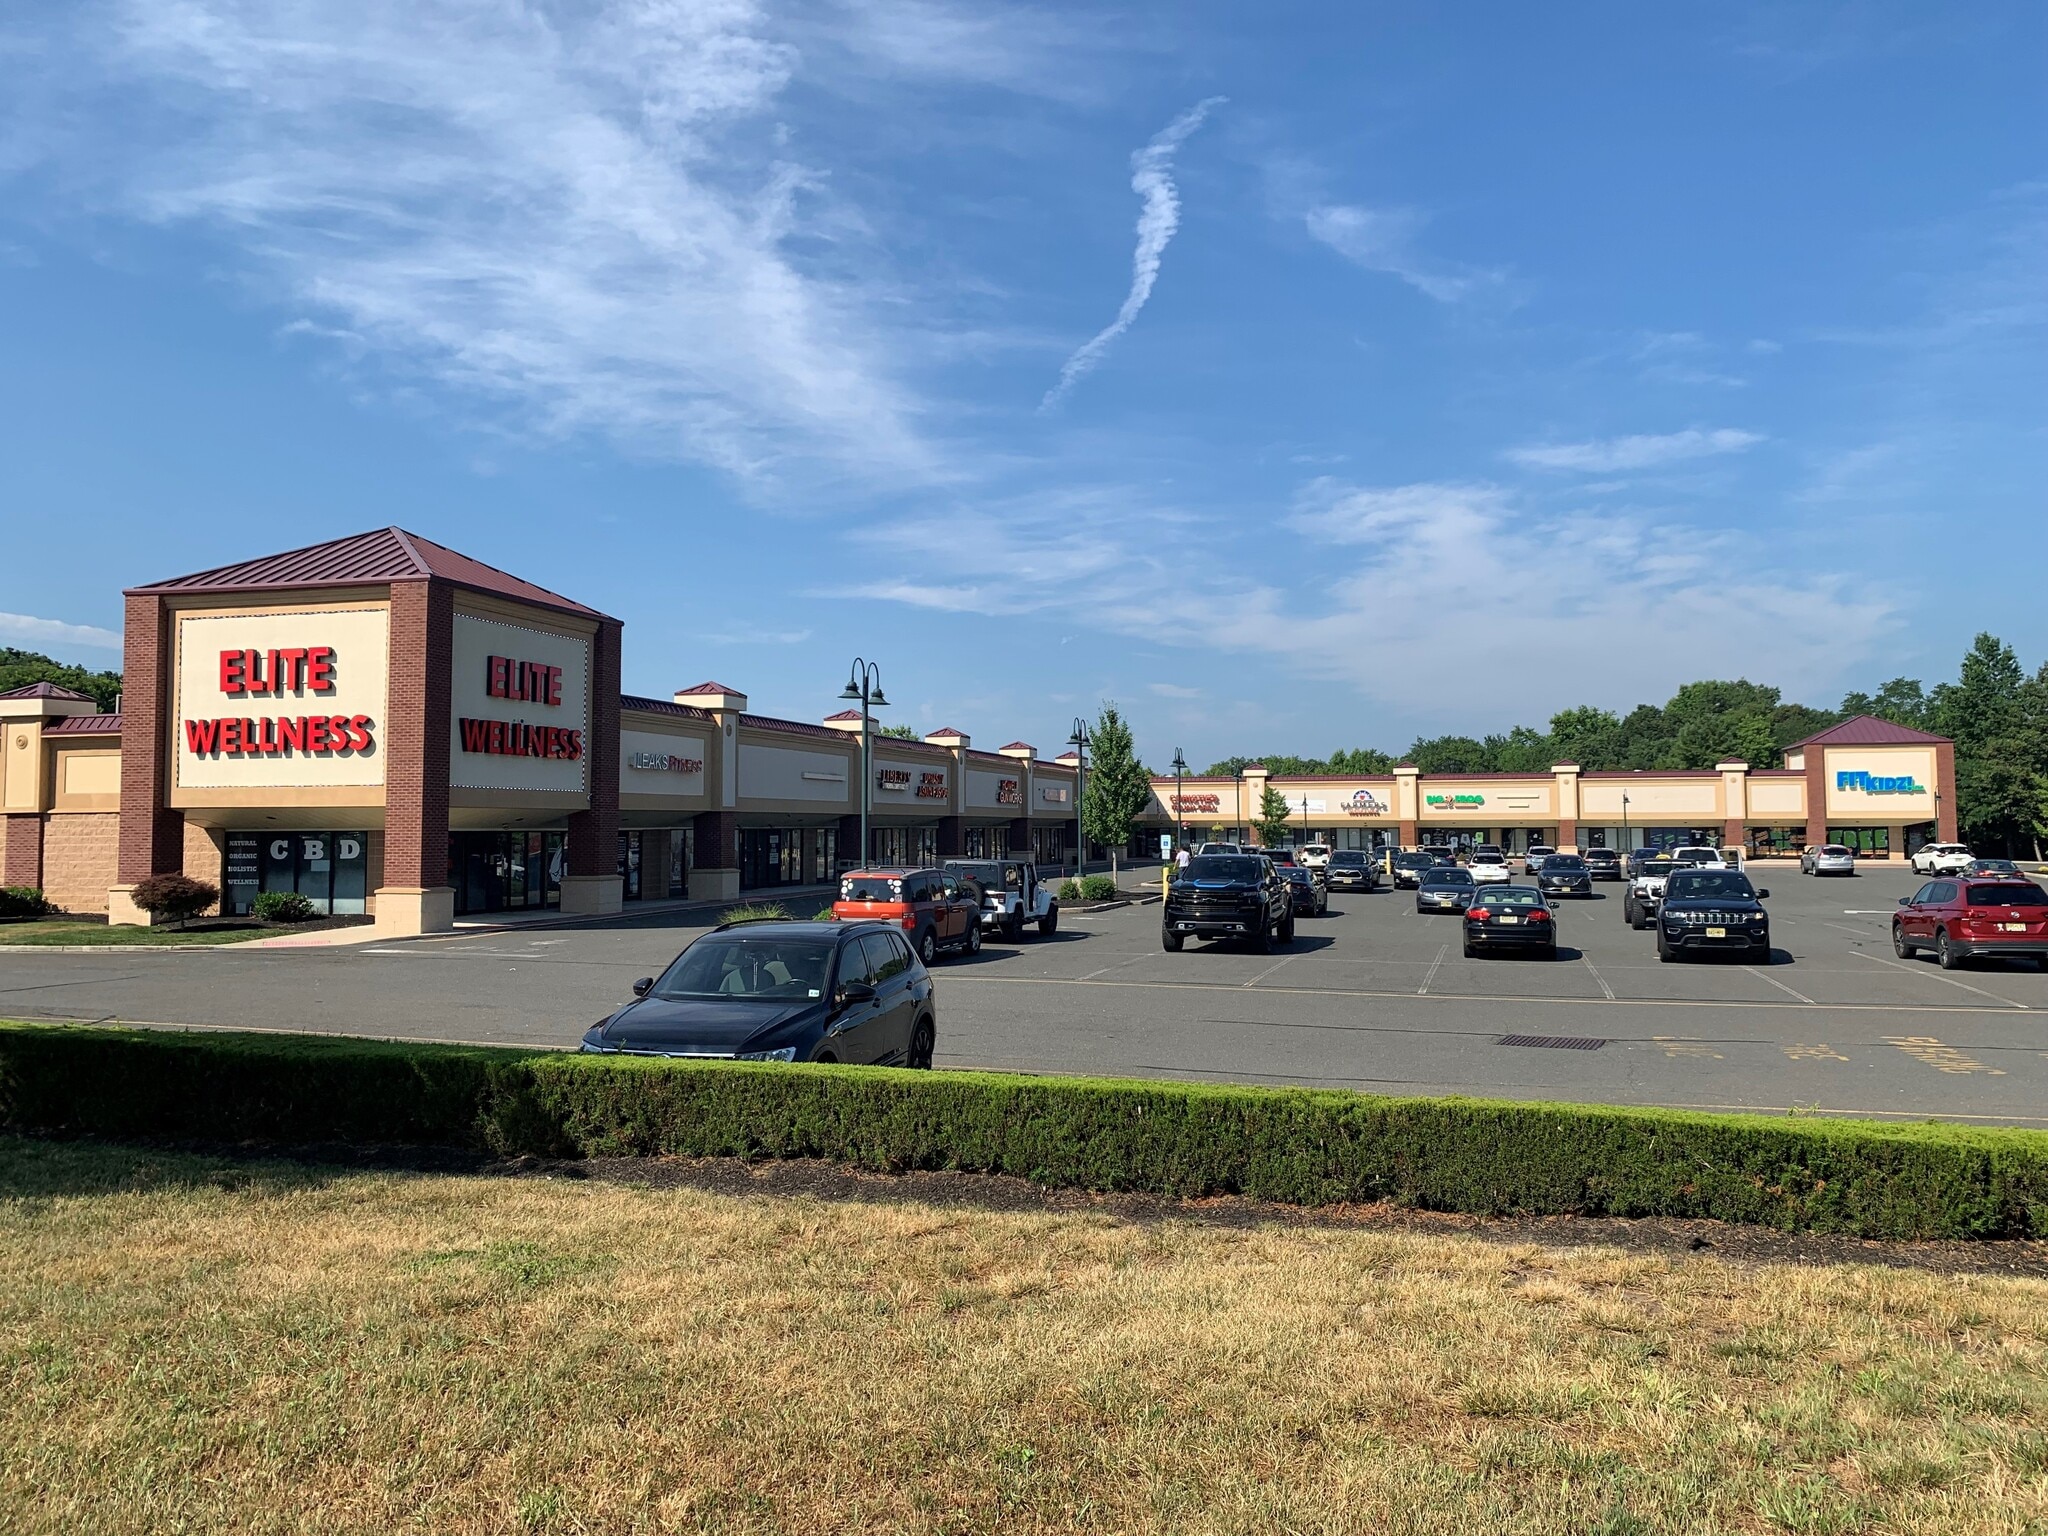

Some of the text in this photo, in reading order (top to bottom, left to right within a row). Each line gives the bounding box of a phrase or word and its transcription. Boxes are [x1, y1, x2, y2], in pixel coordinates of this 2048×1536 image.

[220, 647, 333, 692] ELITE
[486, 655, 562, 706] ELITE
[185, 715, 371, 753] WELLNESS
[459, 718, 583, 760] WELLNESS
[635, 752, 668, 770] LEAKS
[1836, 771, 1868, 789] FIT
[1341, 801, 1387, 811] FARMERS
